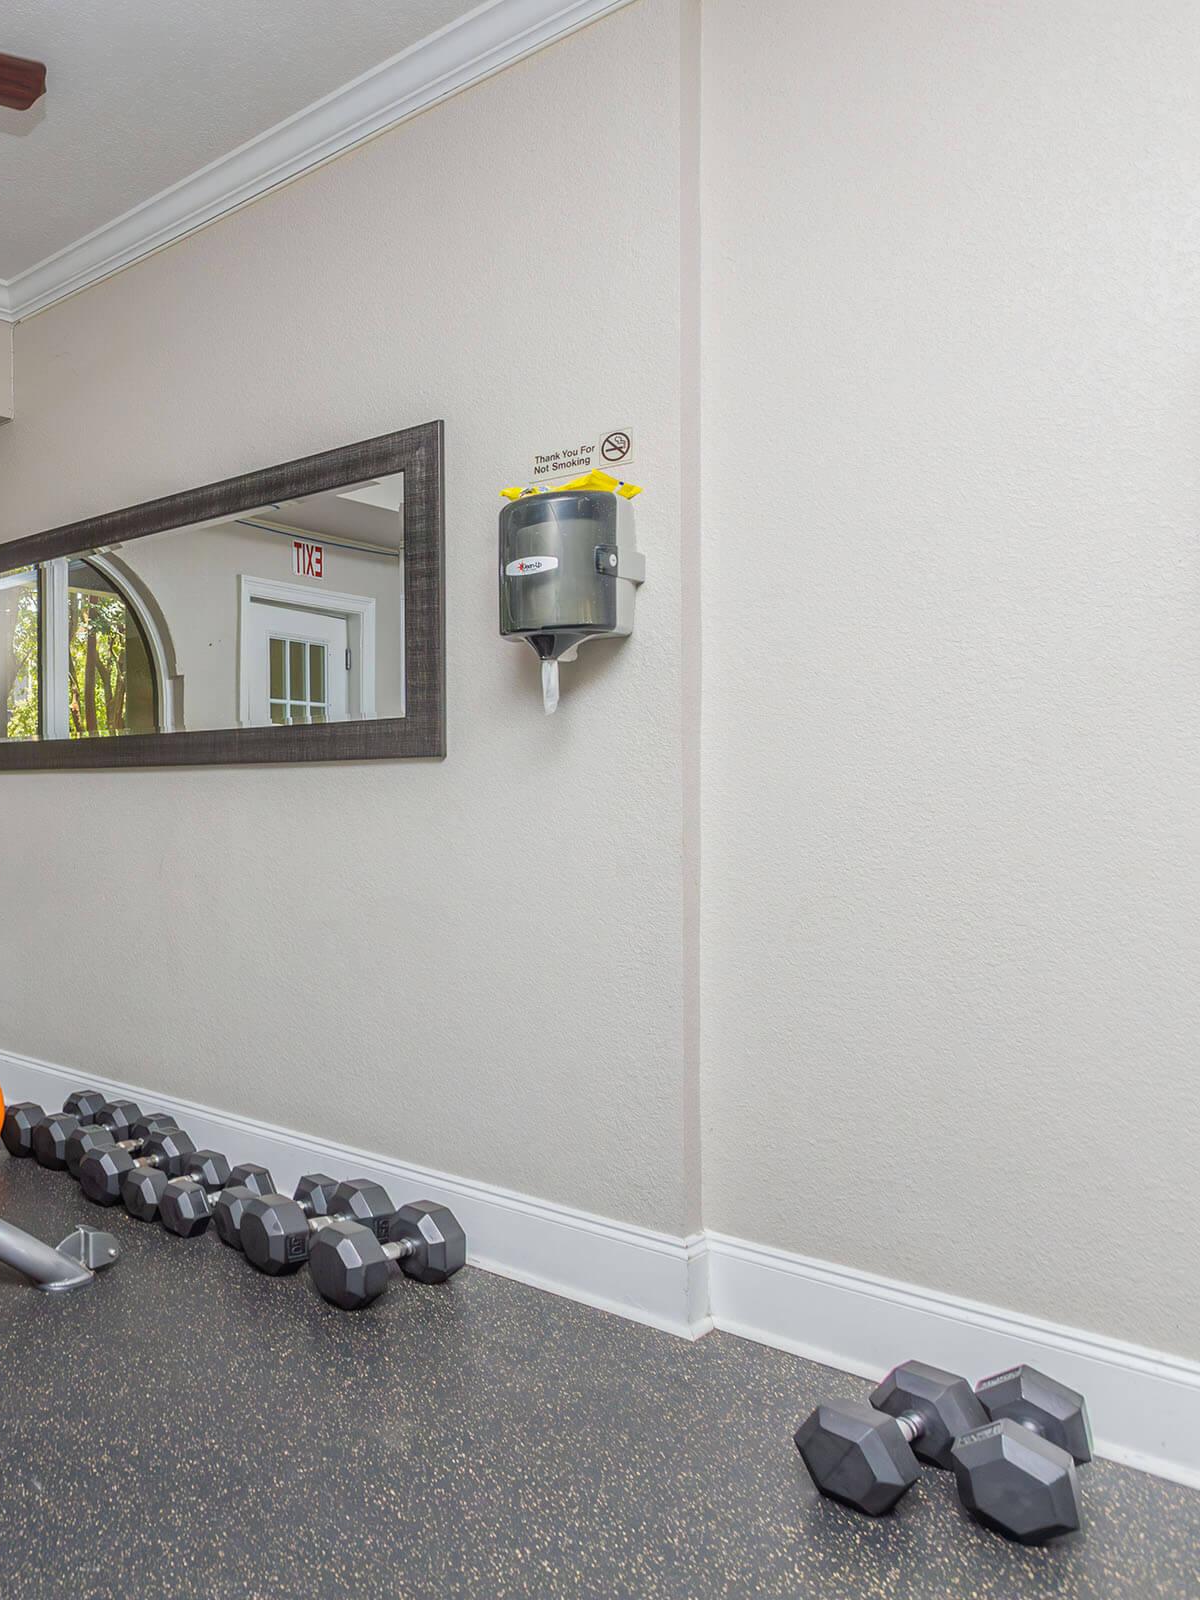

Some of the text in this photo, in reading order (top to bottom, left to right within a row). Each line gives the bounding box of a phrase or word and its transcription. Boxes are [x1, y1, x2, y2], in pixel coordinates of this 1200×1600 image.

[535, 445, 595, 464] Thank You For
[534, 457, 590, 475] Not Smoking
